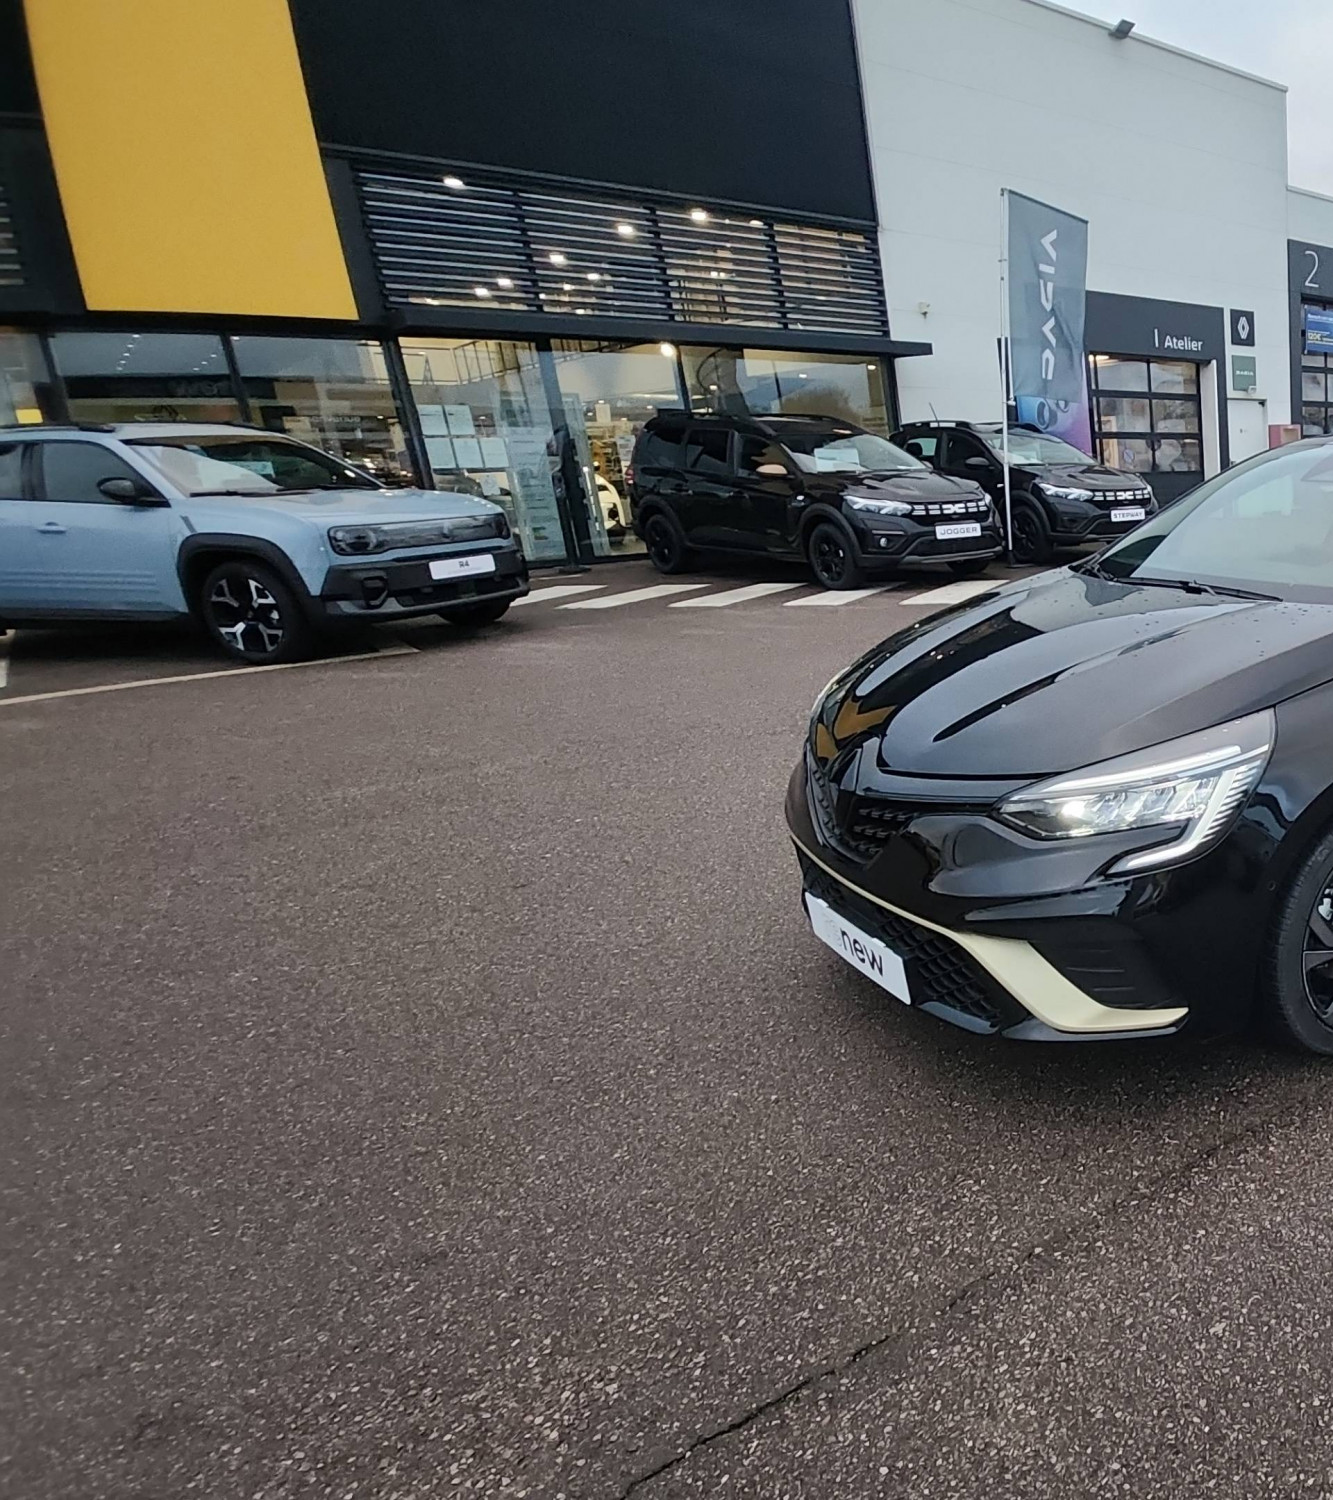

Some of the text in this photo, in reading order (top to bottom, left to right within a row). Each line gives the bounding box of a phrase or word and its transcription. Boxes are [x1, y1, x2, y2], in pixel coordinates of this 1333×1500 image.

[1304, 250, 1319, 287] 2
[1039, 229, 1057, 380] DACIA
[1164, 335, 1203, 351] Atelier
[1113, 510, 1144, 519] STEPWAY
[939, 526, 978, 536] JOGGER
